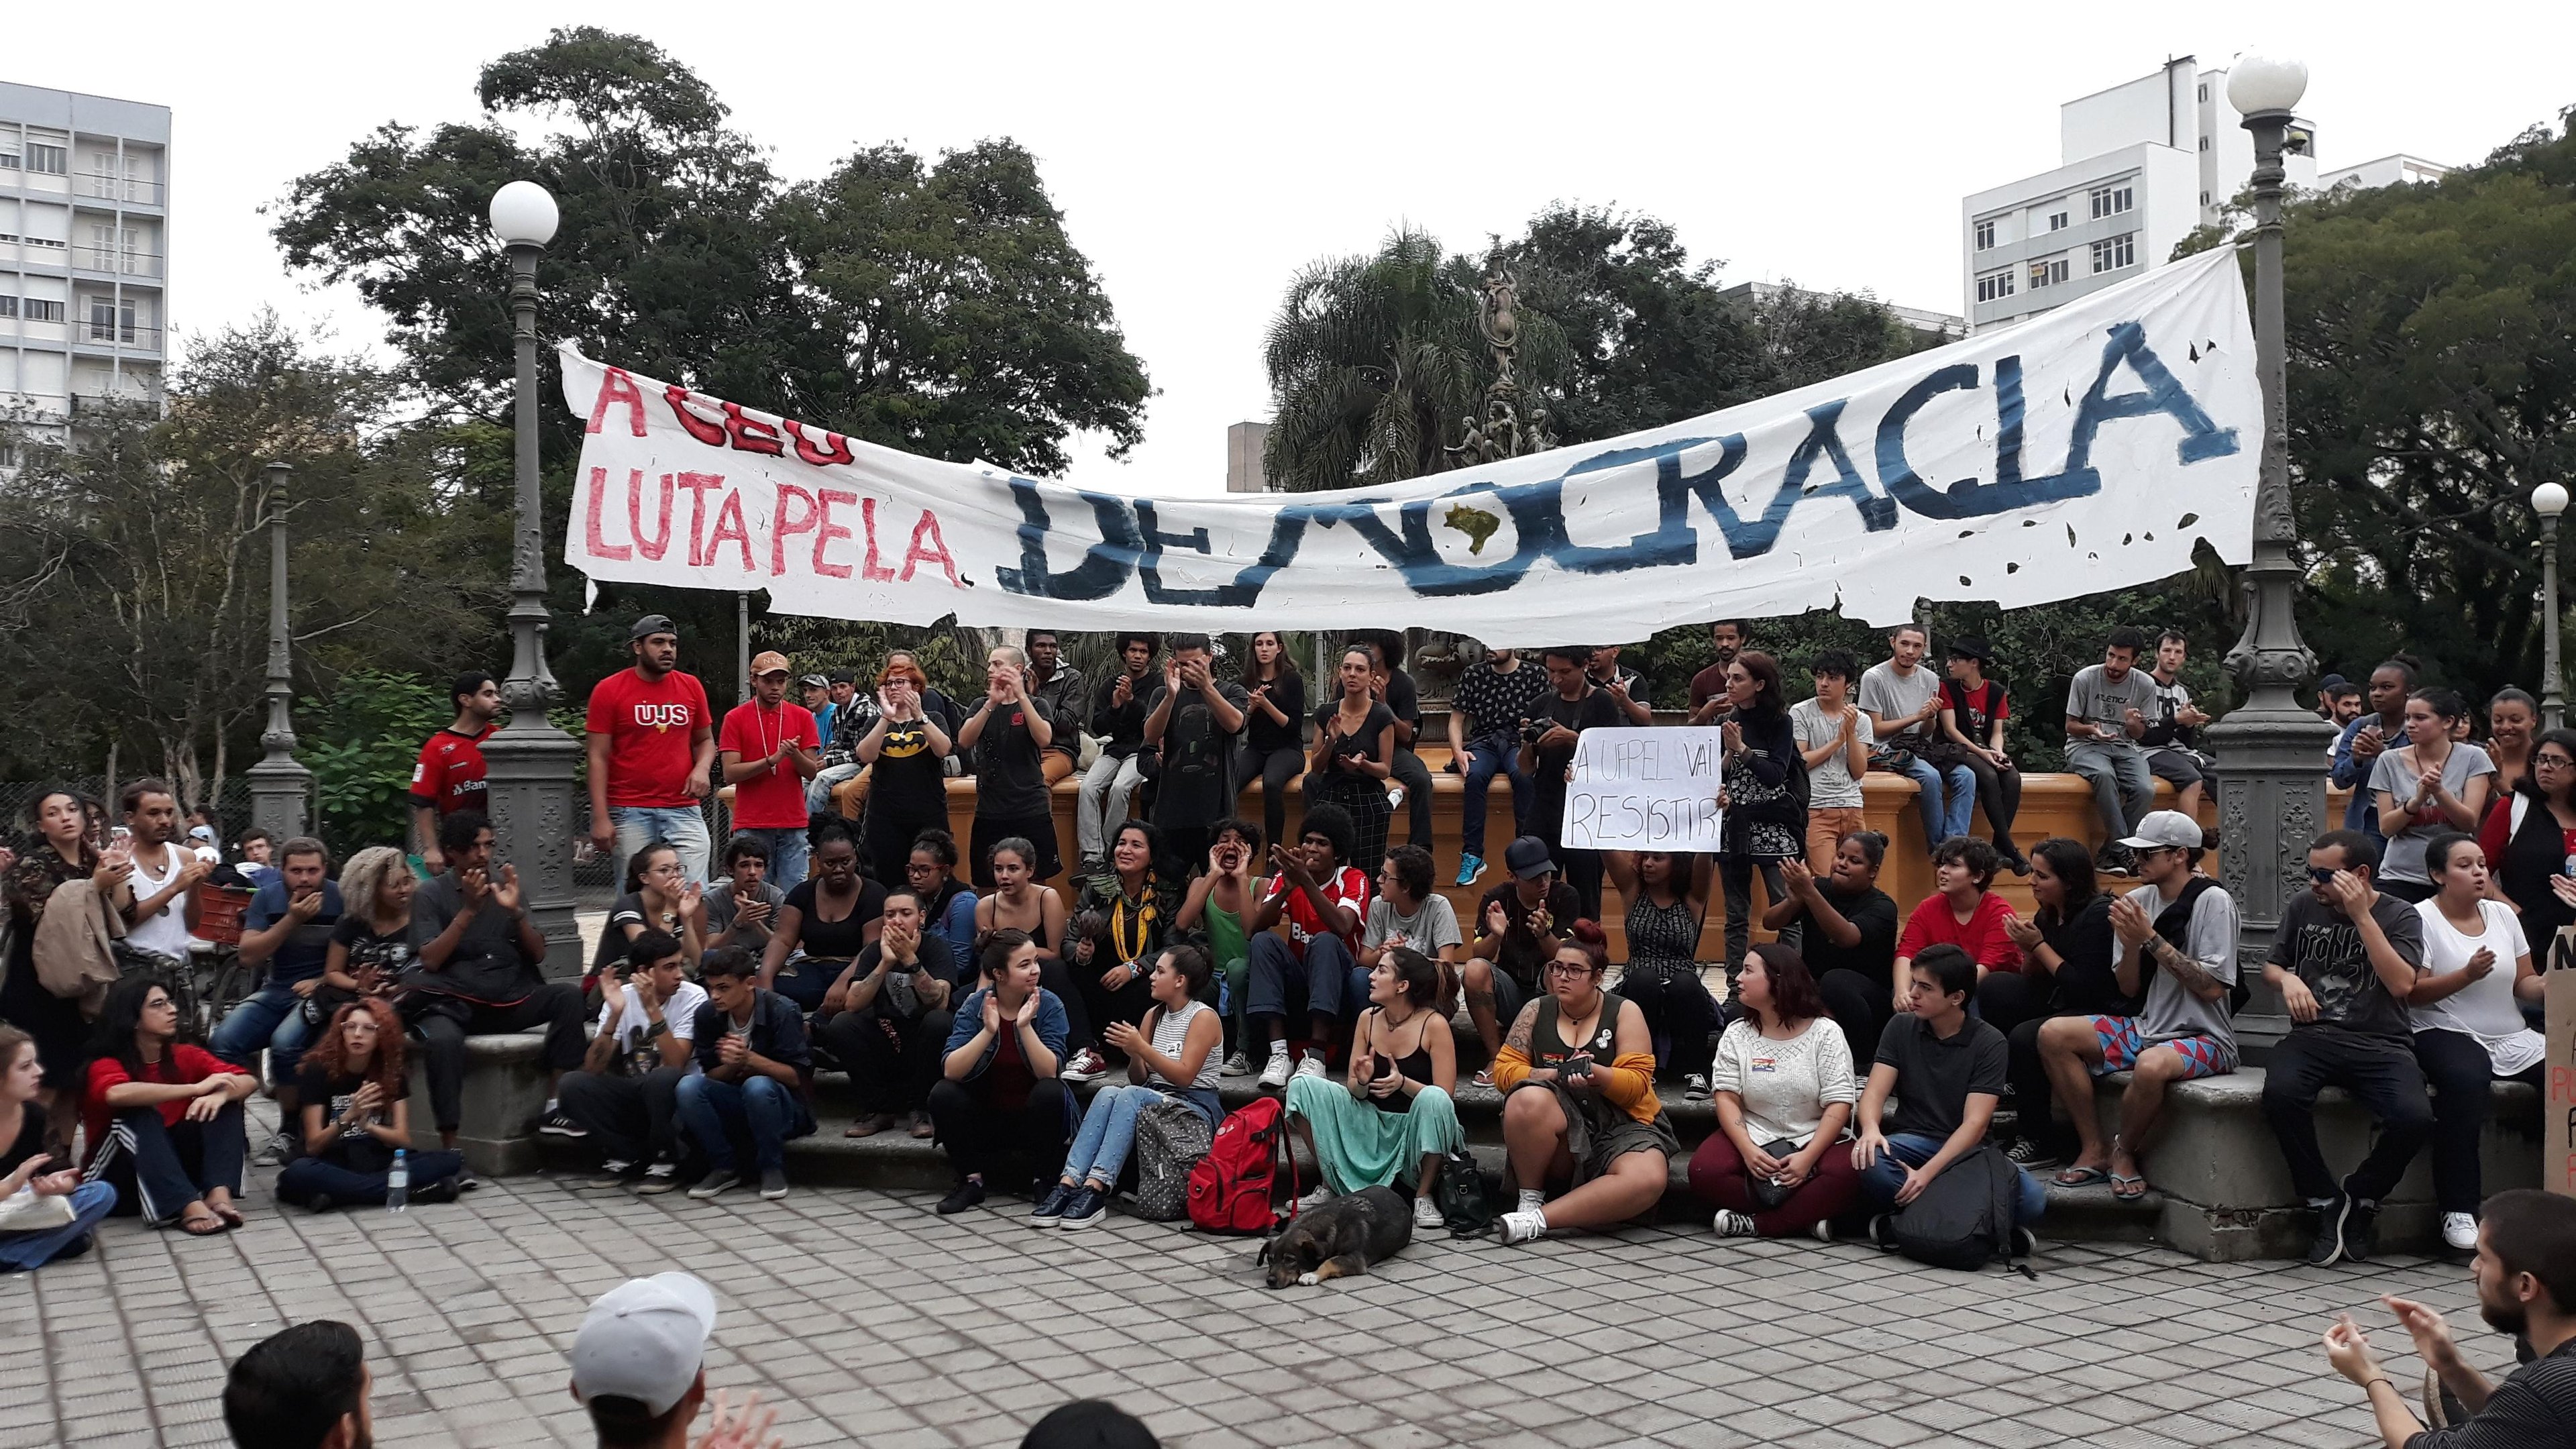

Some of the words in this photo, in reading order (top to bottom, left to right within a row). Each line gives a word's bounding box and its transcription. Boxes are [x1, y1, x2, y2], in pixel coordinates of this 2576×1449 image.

[587, 367, 647, 437] A
[996, 321, 2241, 608] DEMOCRACIA
[586, 468, 756, 572] LUTA
[771, 484, 968, 589] PELA
[763, 657, 784, 665] NYC
[635, 704, 689, 726] UJS
[1571, 741, 1590, 787] A
[1601, 739, 1674, 782] UFPEL
